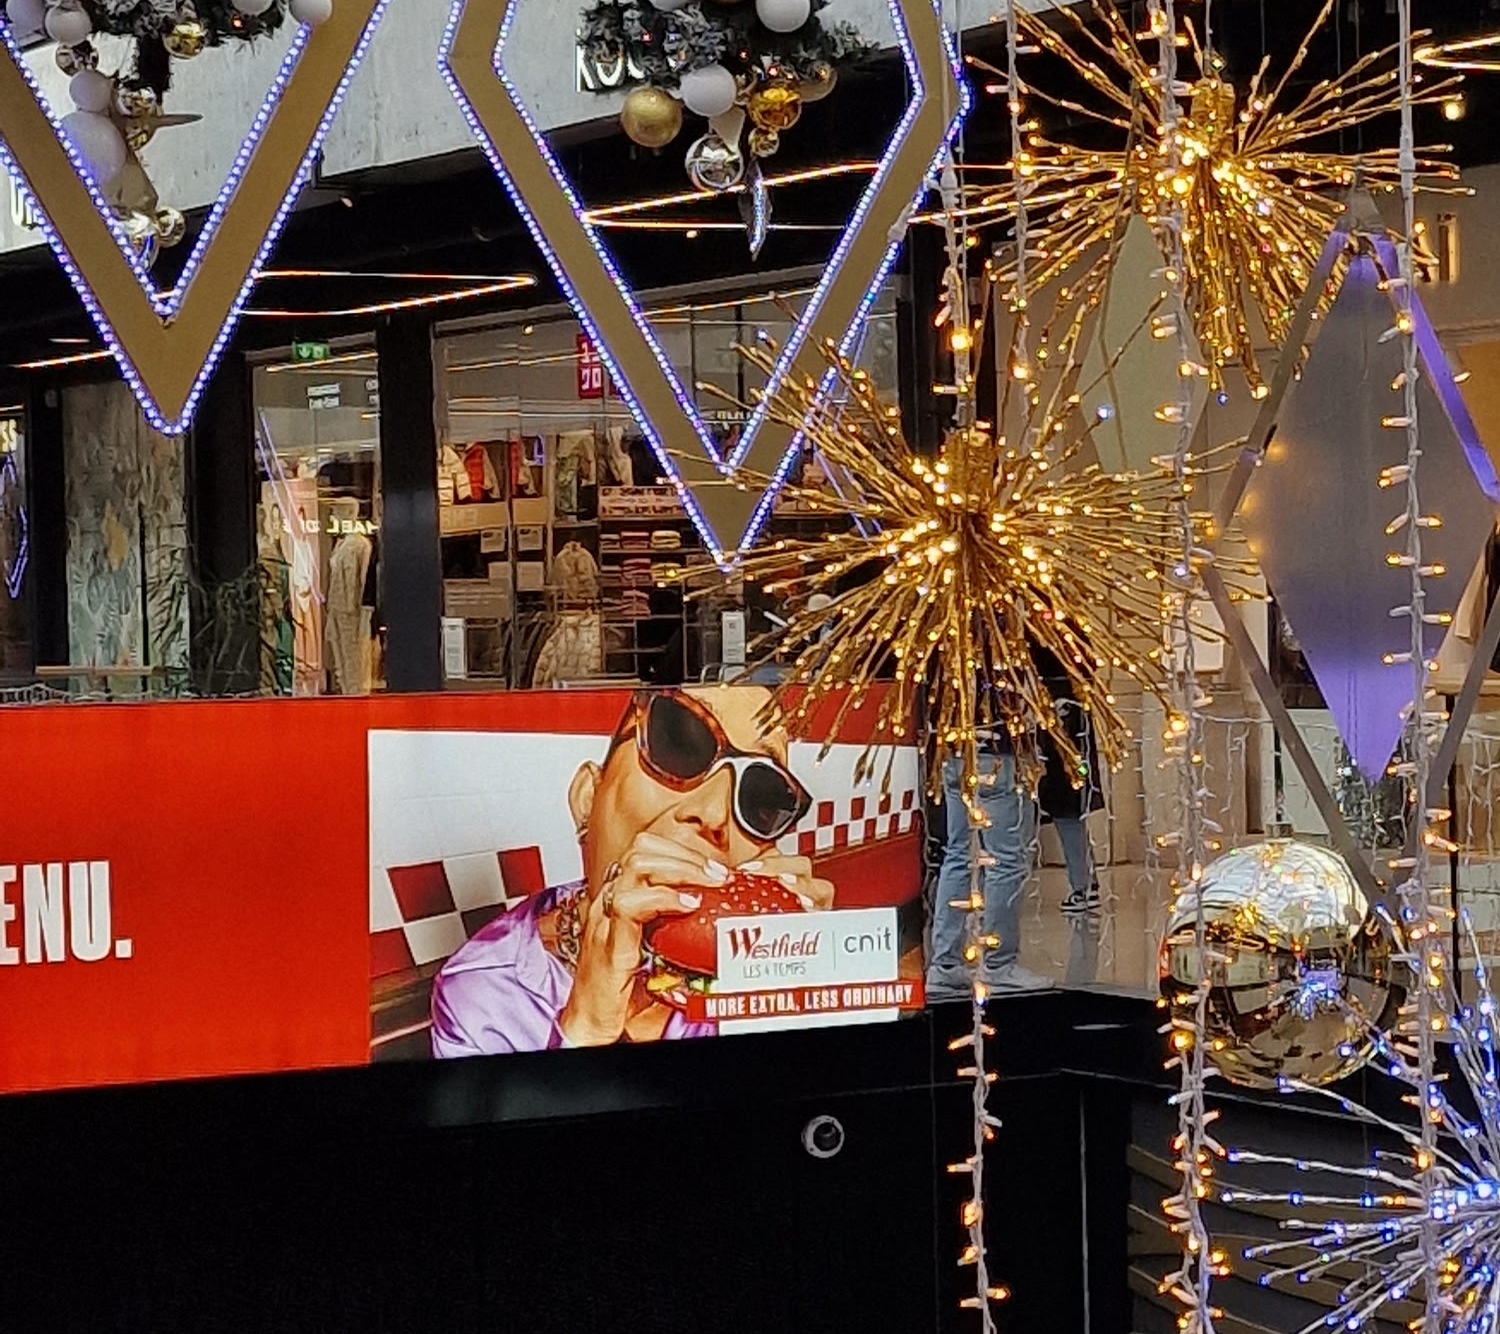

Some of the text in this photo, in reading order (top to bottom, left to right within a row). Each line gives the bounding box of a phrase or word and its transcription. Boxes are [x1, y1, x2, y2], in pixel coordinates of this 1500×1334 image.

[0, 860, 133, 965] ENU.
[725, 924, 892, 961] Westfield cnit
[742, 963, 762, 979] LES
[704, 995, 746, 1018] MORE
[803, 988, 840, 1010] LESS
[842, 983, 914, 1008] ORDINARY
